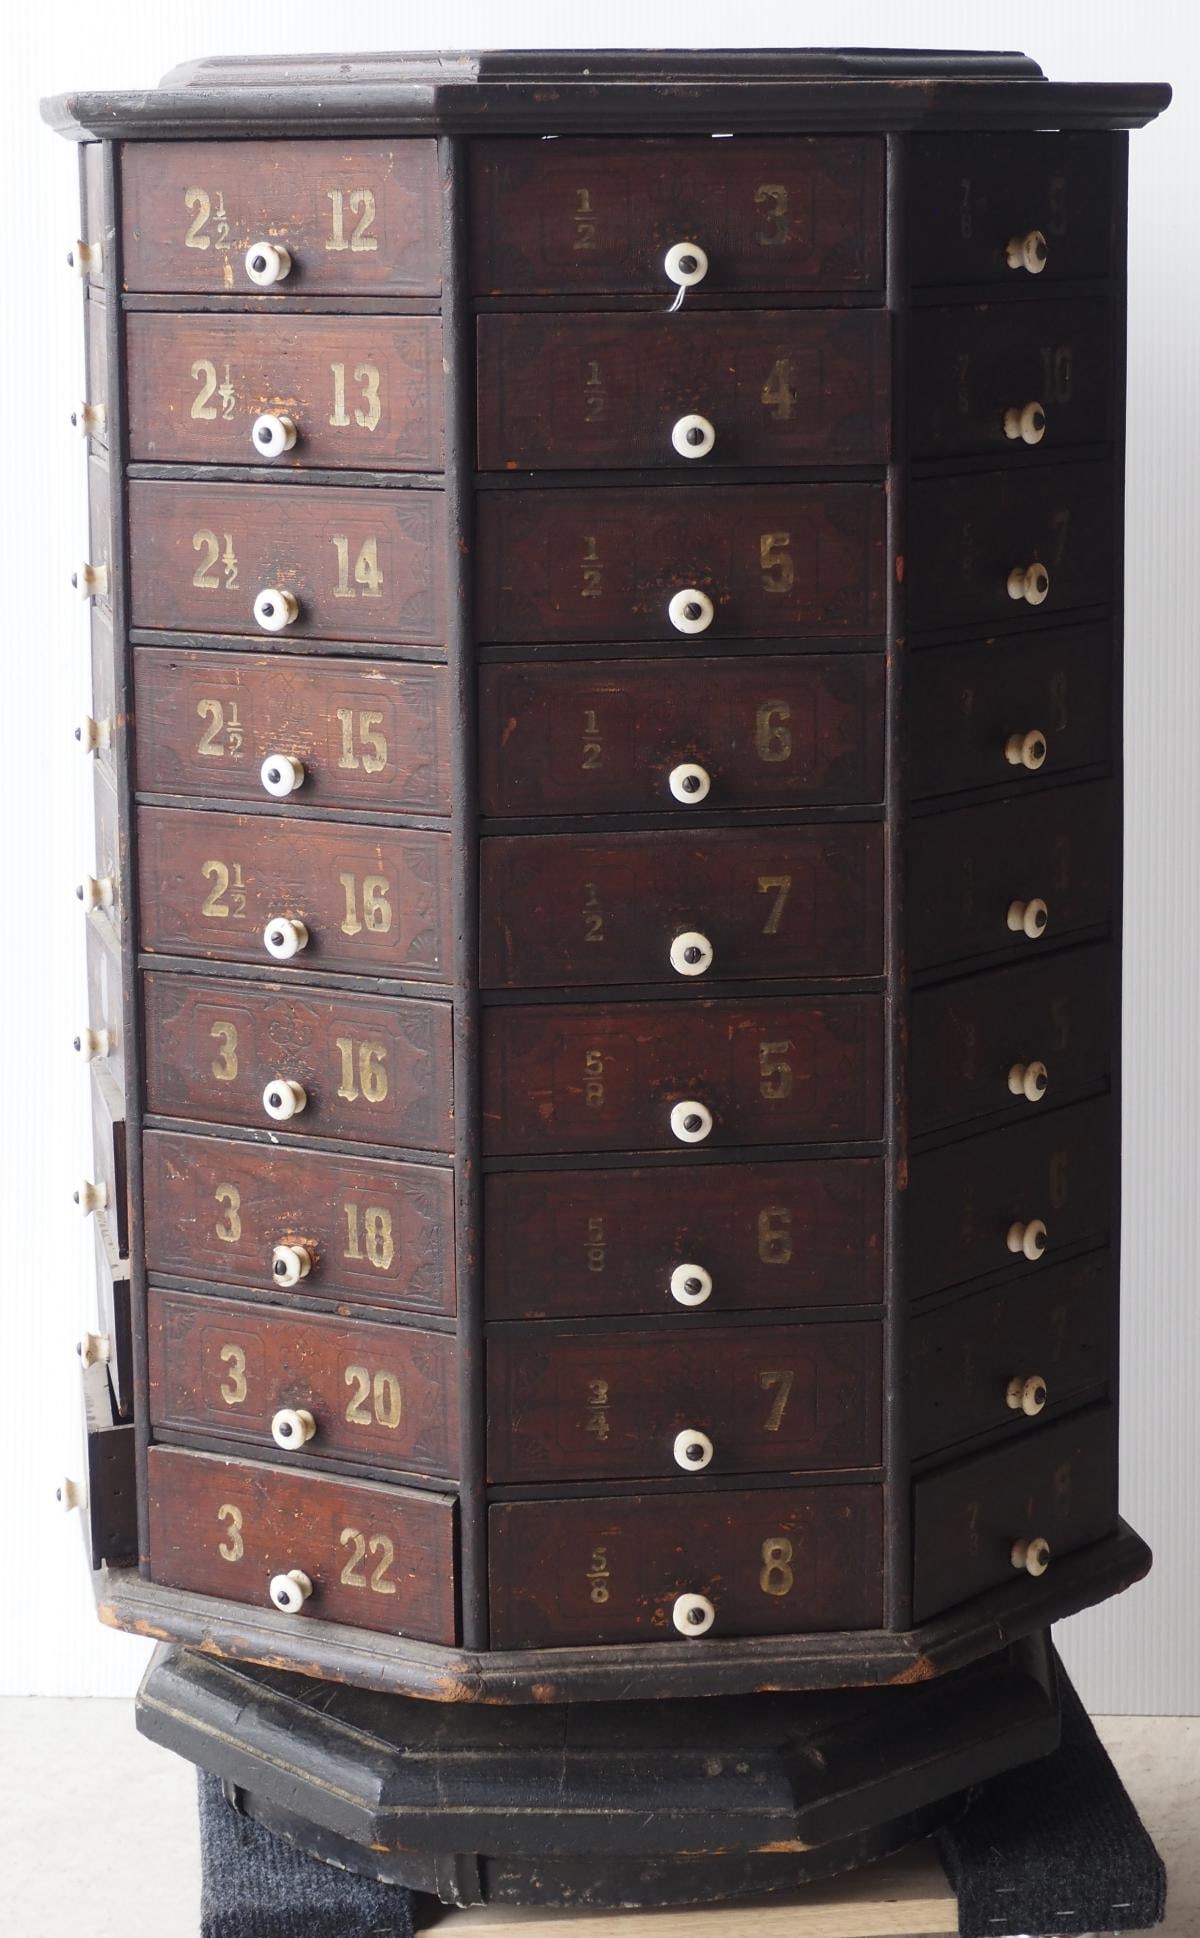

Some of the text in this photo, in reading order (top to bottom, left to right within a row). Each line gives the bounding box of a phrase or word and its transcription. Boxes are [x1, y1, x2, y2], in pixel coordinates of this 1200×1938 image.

[325, 188, 378, 251] 12
[330, 362, 381, 432] 13
[760, 359, 797, 421] 4
[329, 533, 383, 598] 14
[760, 532, 793, 593] 5
[337, 708, 387, 774] 15
[756, 700, 792, 762] 6
[339, 872, 391, 936] 16
[757, 875, 792, 934] 7
[209, 1021, 388, 1102] 3 16
[759, 1041, 792, 1099] 5
[215, 1182, 393, 1270] 3 18
[758, 1206, 792, 1264] 6
[220, 1343, 401, 1429] 3 20
[759, 1370, 794, 1431] 7
[218, 1504, 396, 1594] 3 22
[759, 1537, 793, 1595] 8
